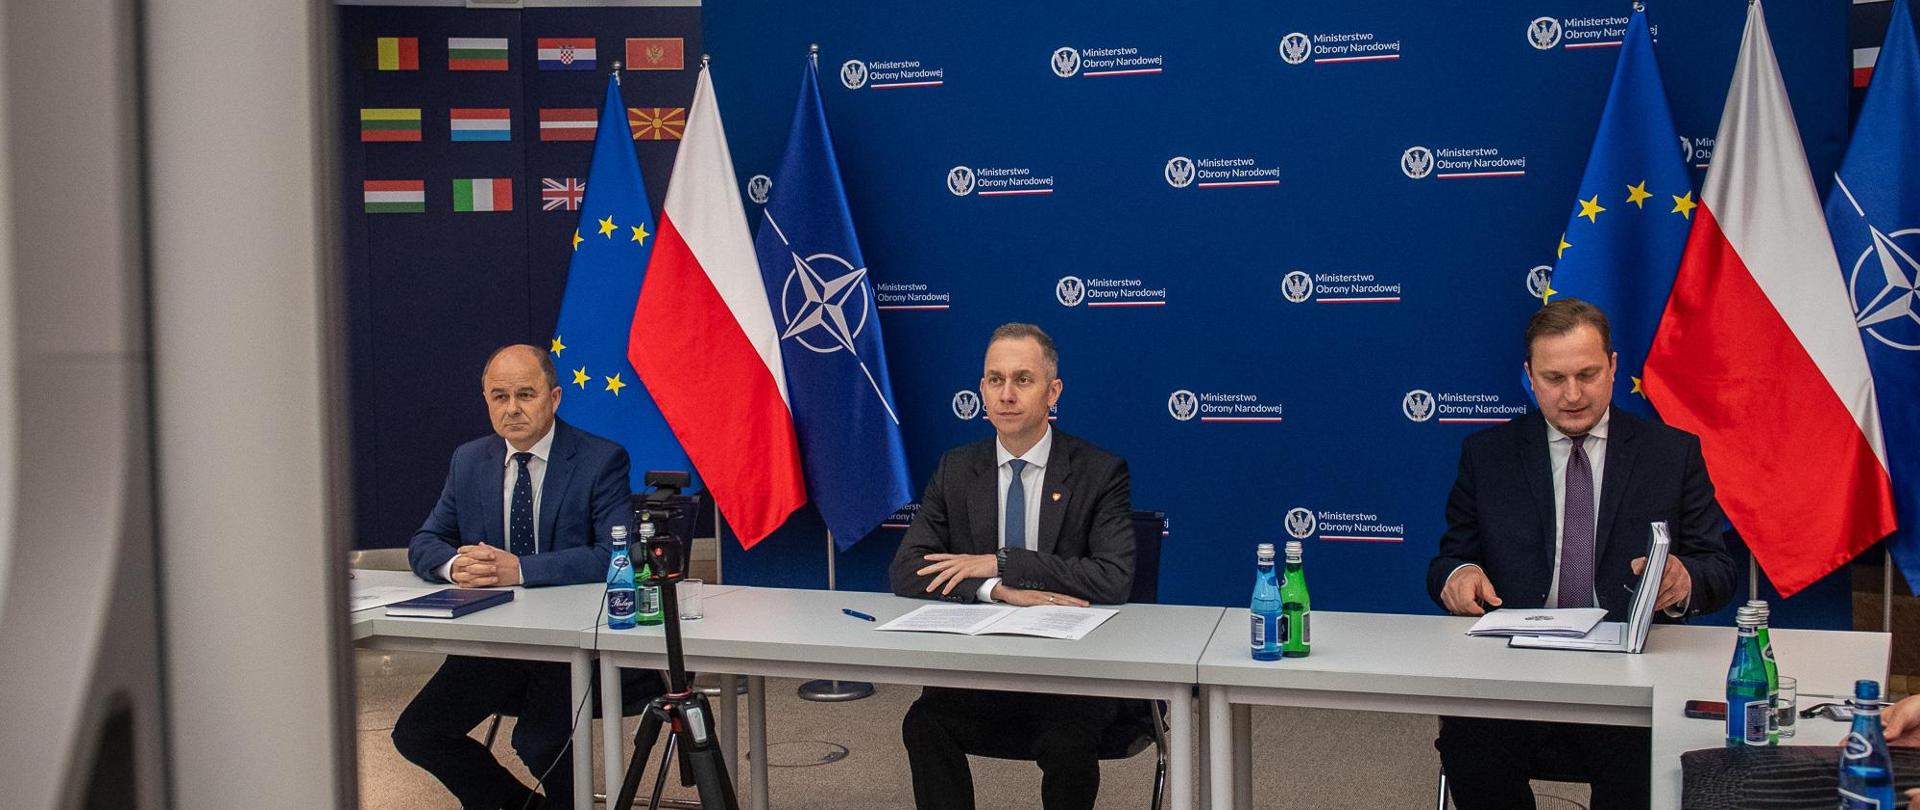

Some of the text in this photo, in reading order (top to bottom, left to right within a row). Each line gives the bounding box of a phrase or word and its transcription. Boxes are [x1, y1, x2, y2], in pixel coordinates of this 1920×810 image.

[1564, 16, 1629, 28] Ministerstwo
[1314, 32, 1373, 43] Ministerstwo
[1564, 28, 1601, 39] Obrony
[1082, 47, 1137, 57] Ministerstwo
[1314, 41, 1400, 54] Obrony Narodowej
[869, 60, 920, 70] Ministerstwo
[1083, 55, 1162, 68] Obrony Narodowej
[870, 68, 943, 80] Obrony Narodowej
[1436, 148, 1498, 157] Ministerstwo
[1197, 158, 1254, 167] Ministerstwo
[1437, 157, 1526, 169] Obrony Narodowej
[977, 168, 1030, 176] Ministerstwo
[1198, 167, 1280, 179] Obrony Narodowej
[977, 176, 1053, 187] Obrony Narodowej
[1087, 278, 1142, 287] Ministerstwo
[1316, 273, 1375, 282] Ministerstwo
[877, 283, 927, 291] Ministerstwo
[1087, 287, 1166, 298] Obrony Narodowej
[1316, 283, 1400, 294] Obrony Narodowej
[877, 291, 950, 302] Obrony Narodowej
[1200, 393, 1257, 402] Ministerstwo
[1438, 393, 1499, 402] Ministerstwo
[1201, 404, 1282, 414] Obrony Narodowej
[1438, 404, 1527, 415] Obrony Narodowej
[1318, 511, 1377, 521] Ministerstwo
[1318, 522, 1404, 534] Obrony Narodowej
